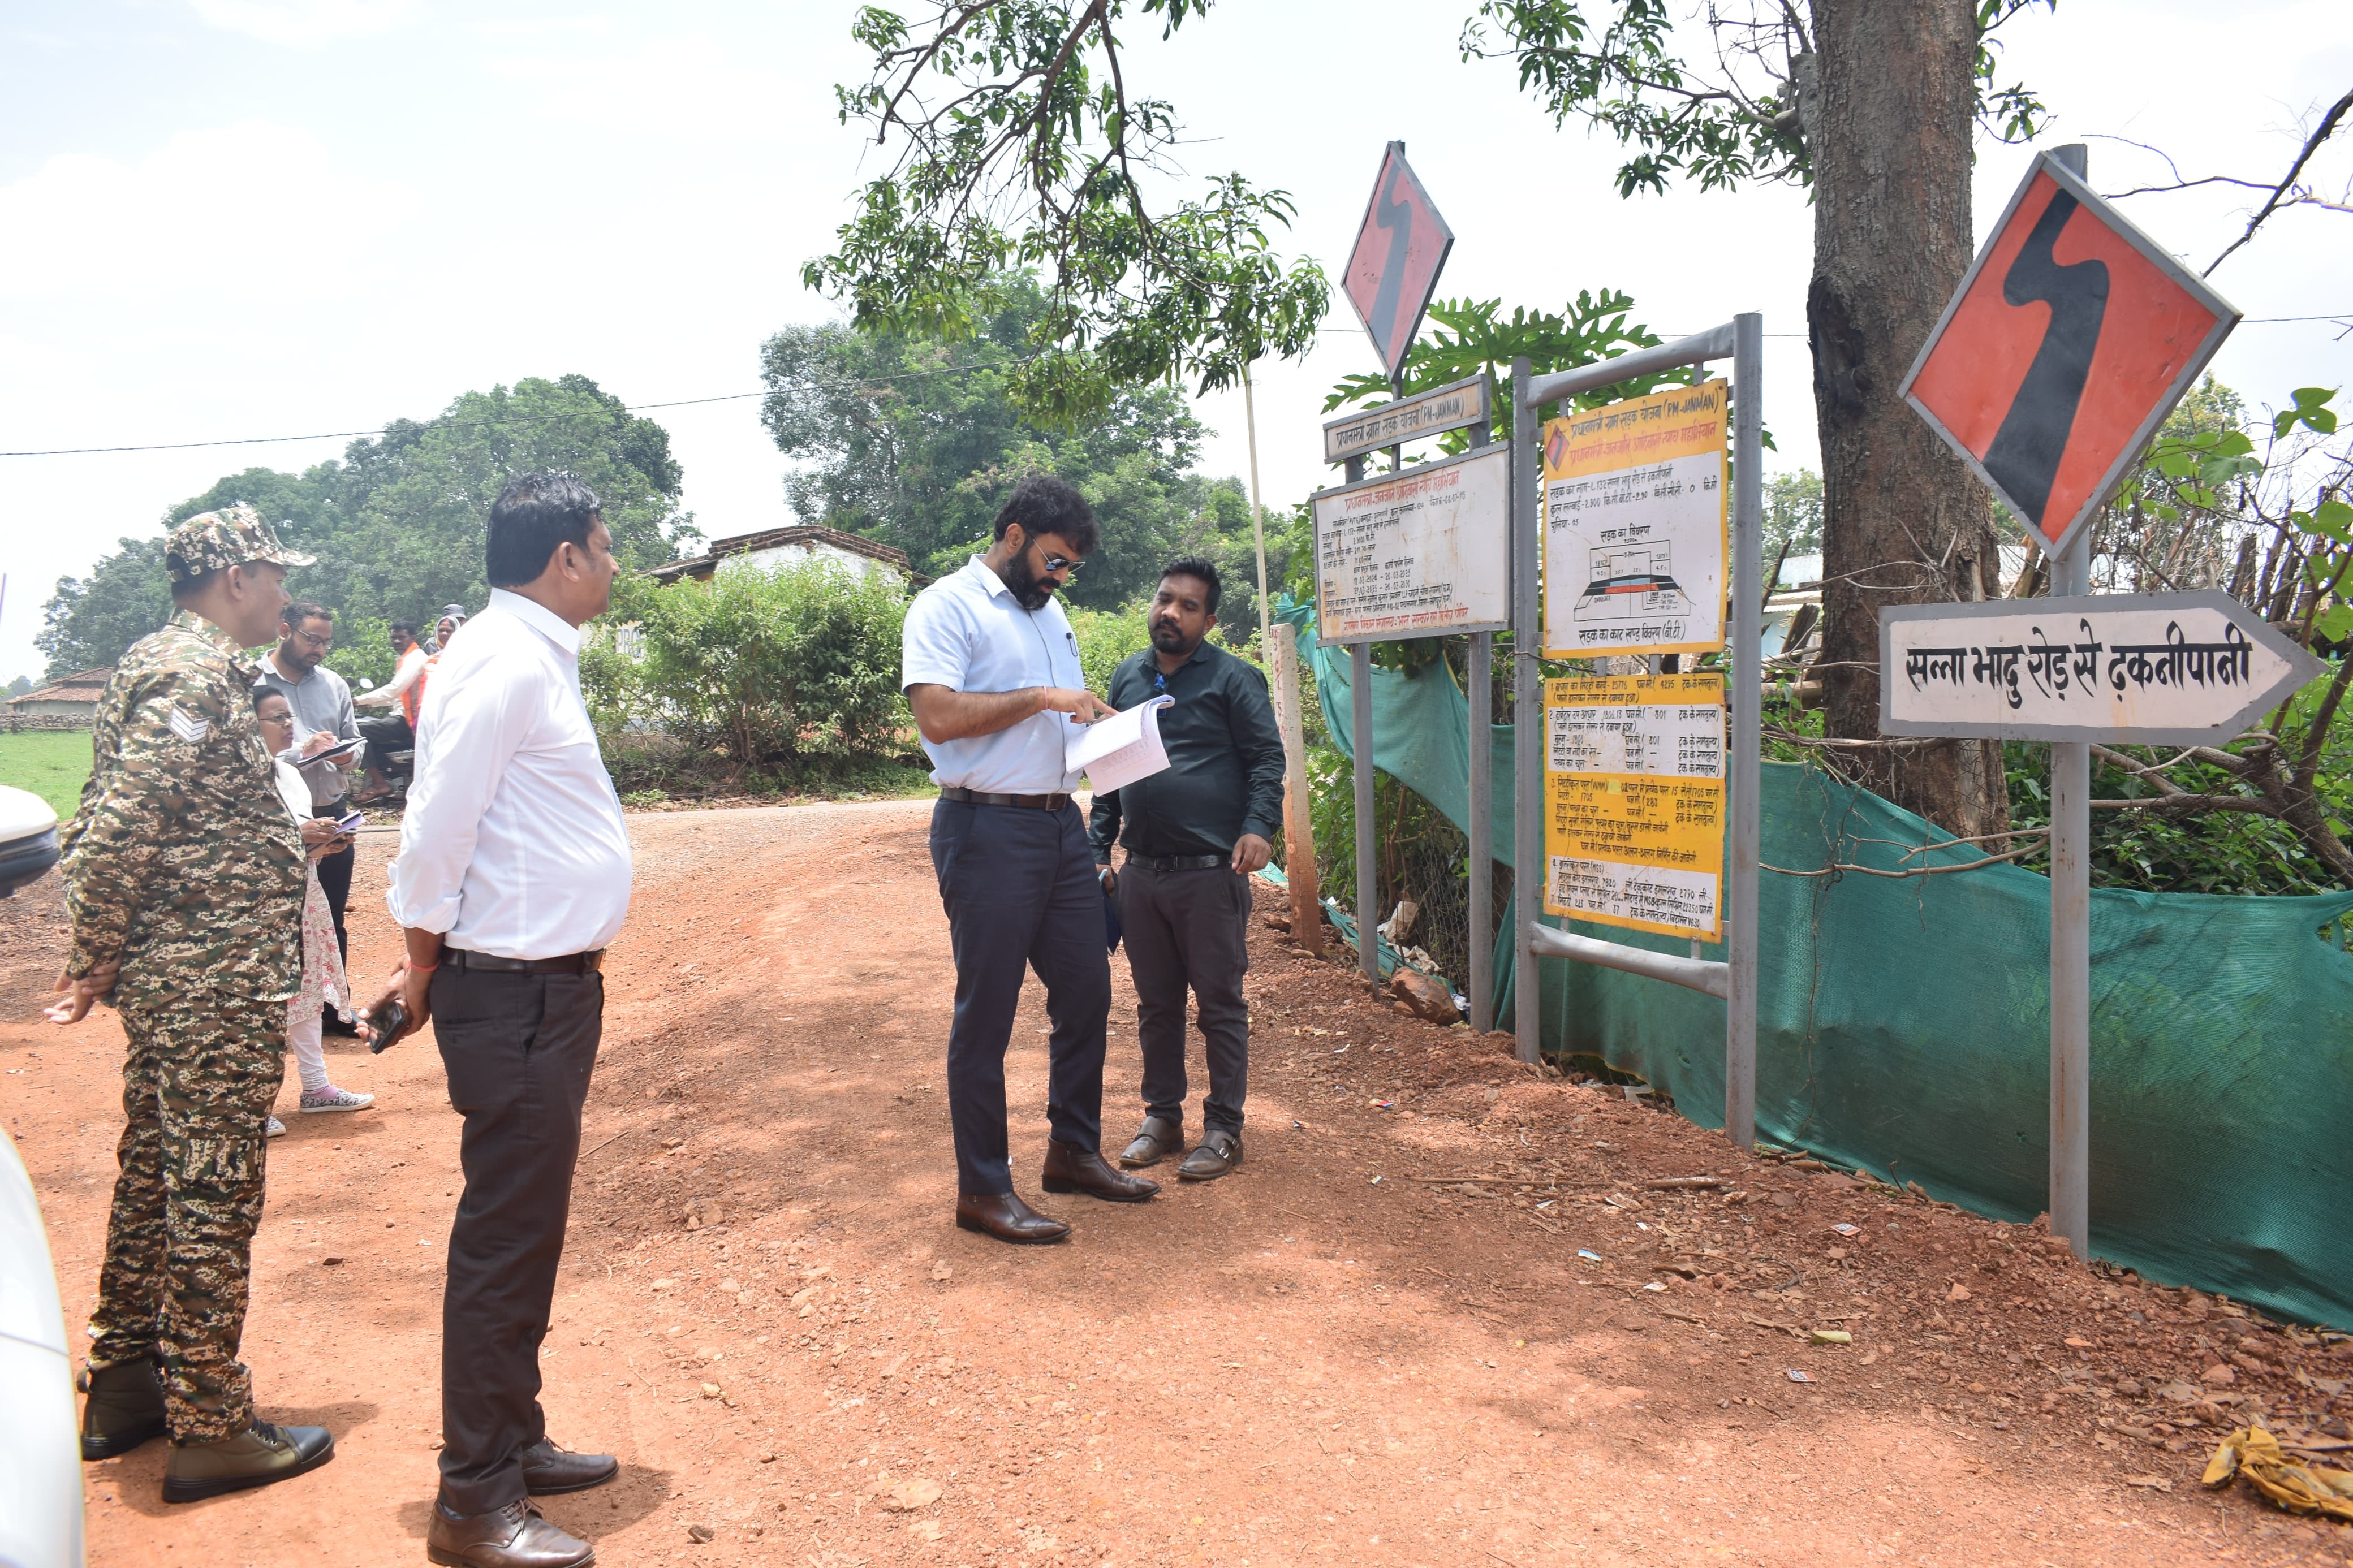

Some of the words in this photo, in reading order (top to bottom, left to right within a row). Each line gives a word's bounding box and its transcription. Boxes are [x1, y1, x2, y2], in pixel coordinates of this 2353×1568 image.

[1600, 530, 1617, 543] सड़क
[1618, 529, 1627, 538] का
[1629, 522, 1651, 538] विवरण
[1579, 629, 1598, 645] सड़क
[1599, 629, 1609, 641] का
[1610, 628, 1624, 641] काट
[1641, 622, 1661, 644] विवरण
[1906, 647, 1967, 692] सन्ना
[1971, 645, 2026, 709] भादु
[2027, 626, 2072, 701] रोड़
[2074, 617, 2103, 697] से
[2108, 620, 2253, 702] ढ़कनीपानी
